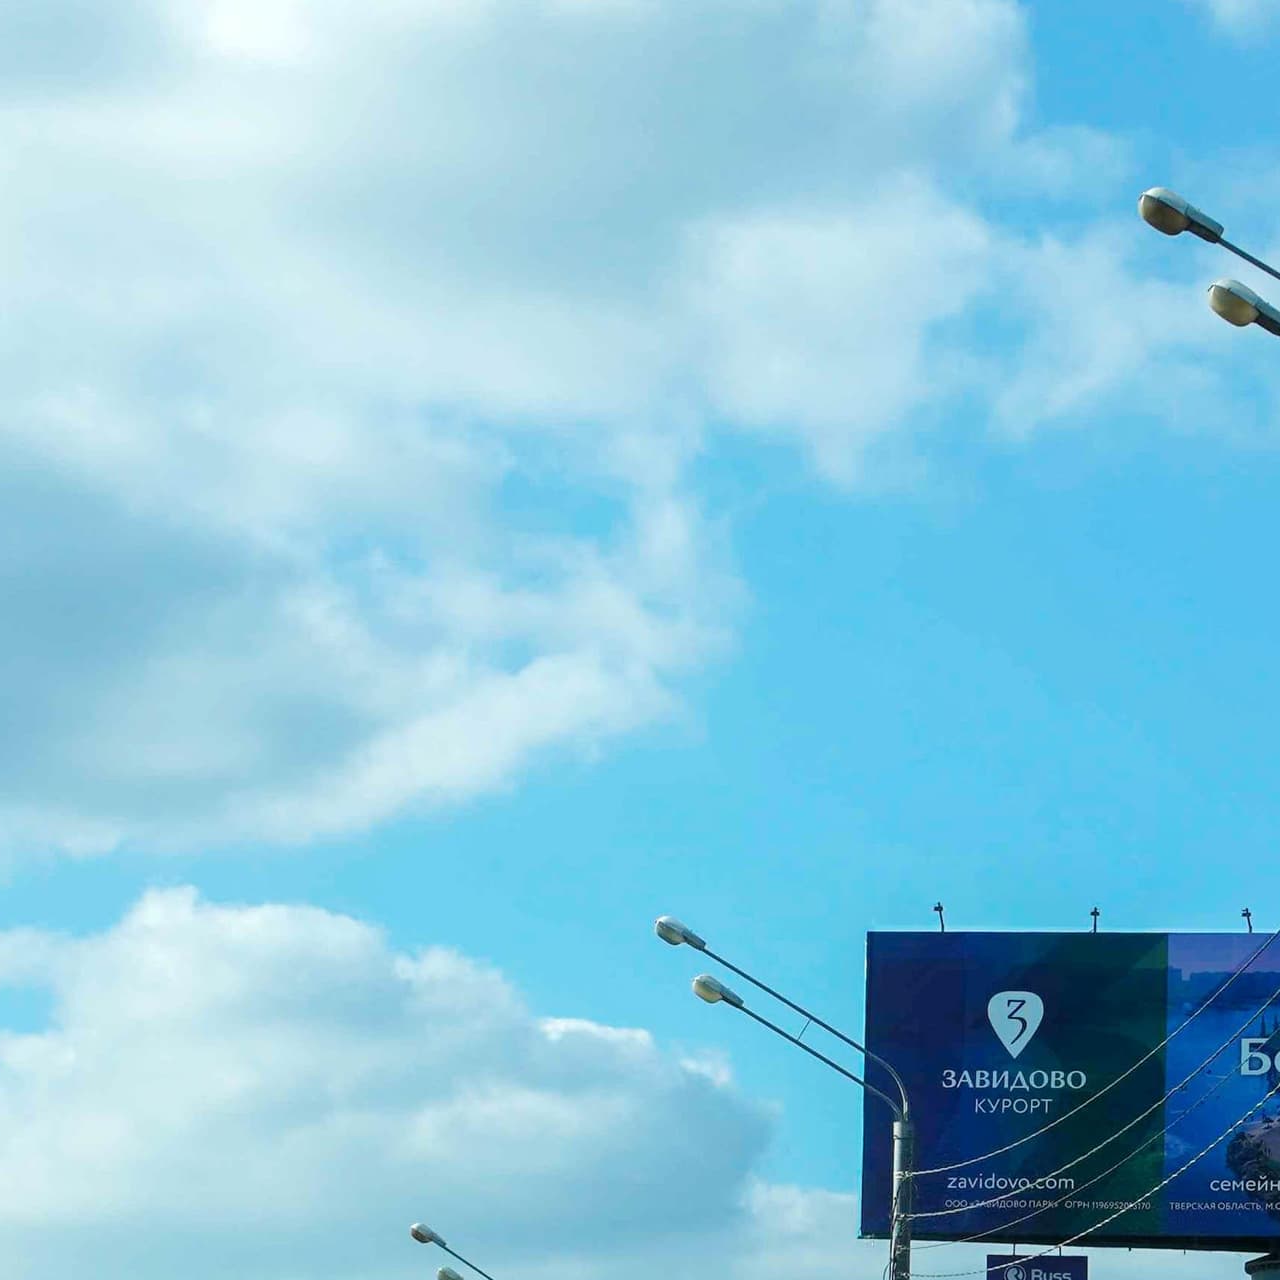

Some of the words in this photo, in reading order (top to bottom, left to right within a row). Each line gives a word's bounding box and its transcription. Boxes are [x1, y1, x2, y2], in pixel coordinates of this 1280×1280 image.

[941, 1069, 1087, 1092] ЗАВИДОВО
[974, 1098, 1053, 1114] КУРОРТ
[946, 1173, 1076, 1190] zavidovo.com
[944, 1199, 968, 1208] ООО
[1064, 1201, 1090, 1210] ОГРН
[1169, 1202, 1216, 1211] ТВЕРСКАЯ
